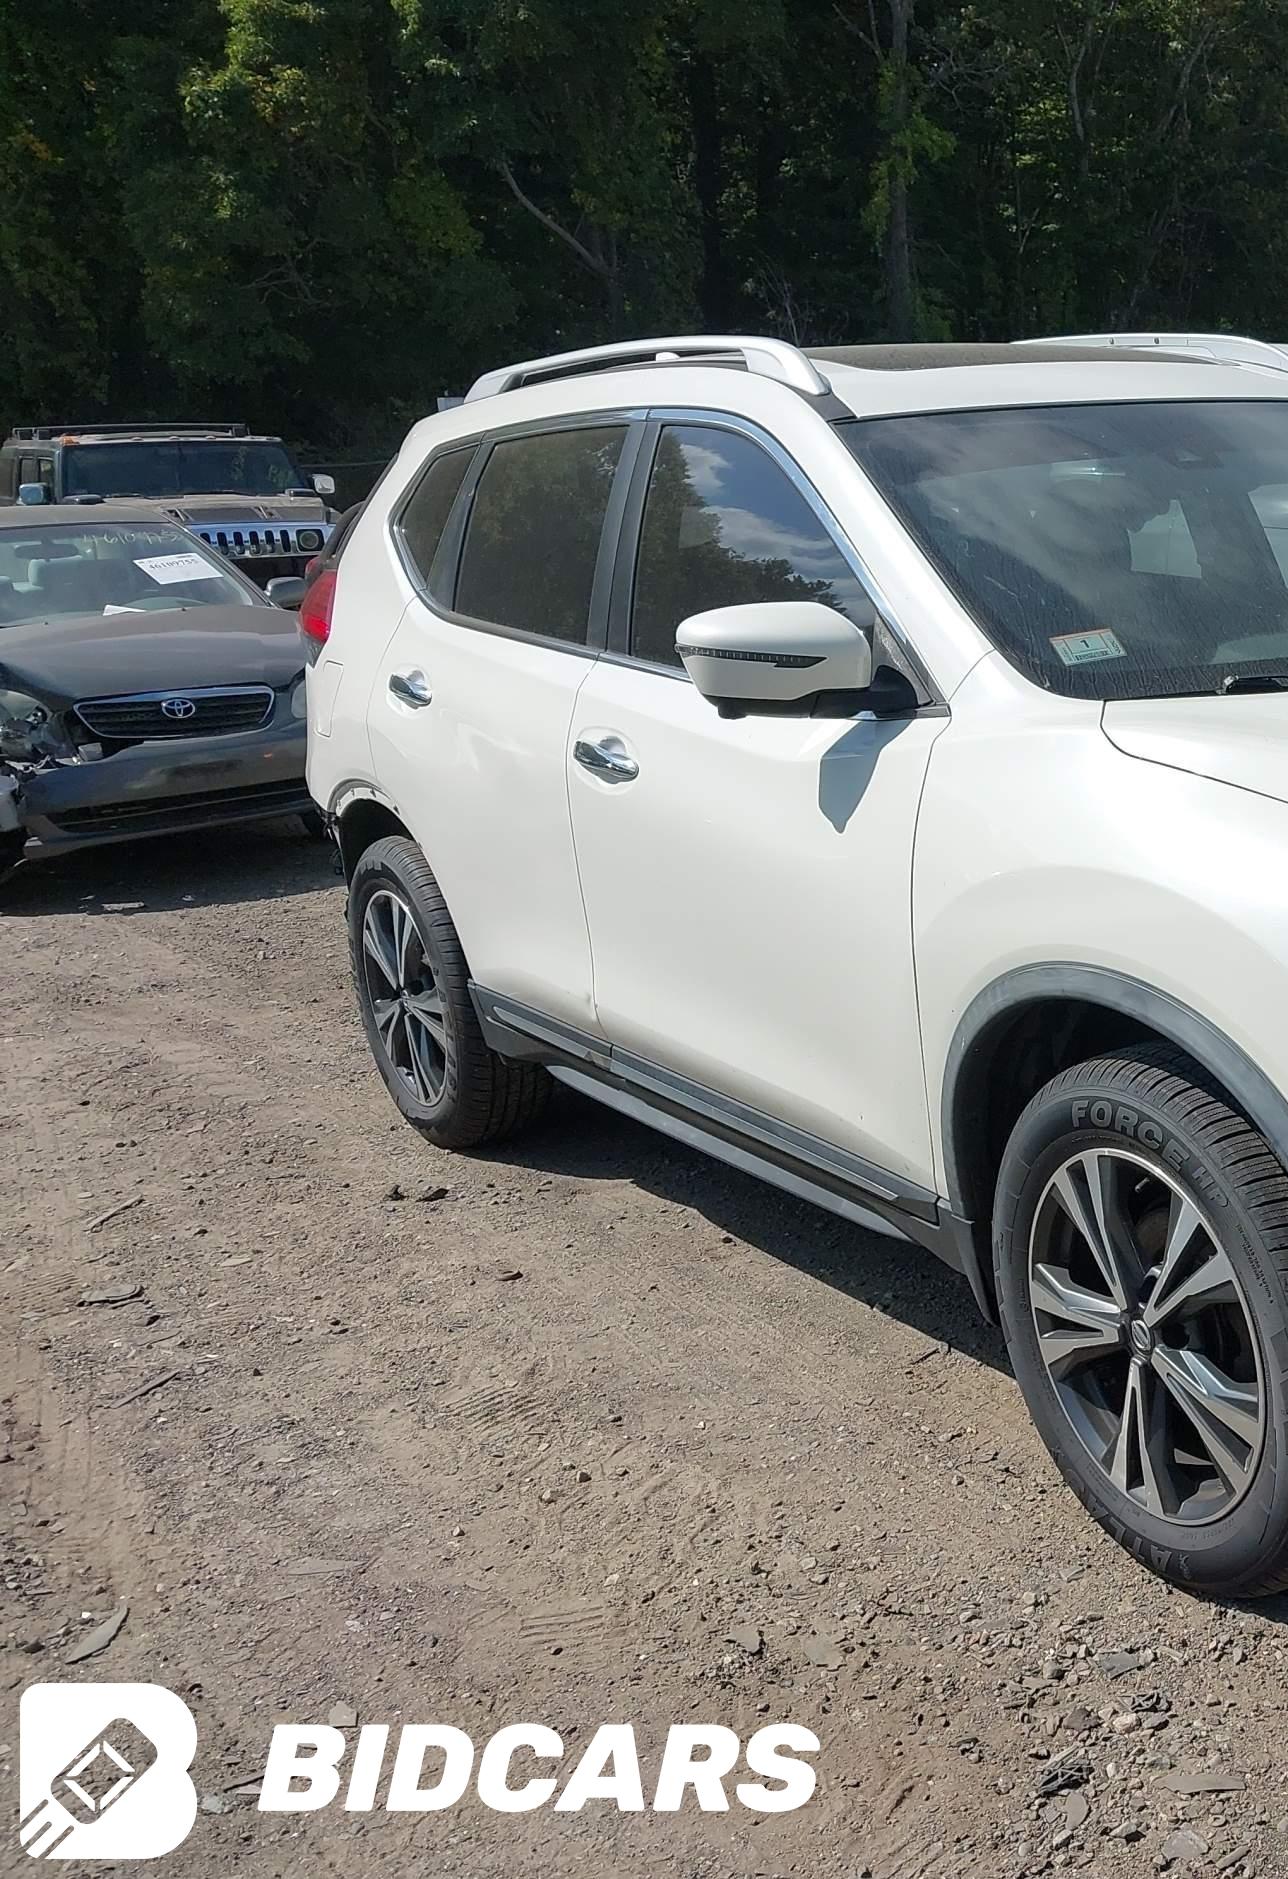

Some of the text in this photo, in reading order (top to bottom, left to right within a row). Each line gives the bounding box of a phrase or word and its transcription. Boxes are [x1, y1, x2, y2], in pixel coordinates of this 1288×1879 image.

[1080, 640, 1090, 649] 1
[1071, 1100, 1230, 1208] FORCE HP
